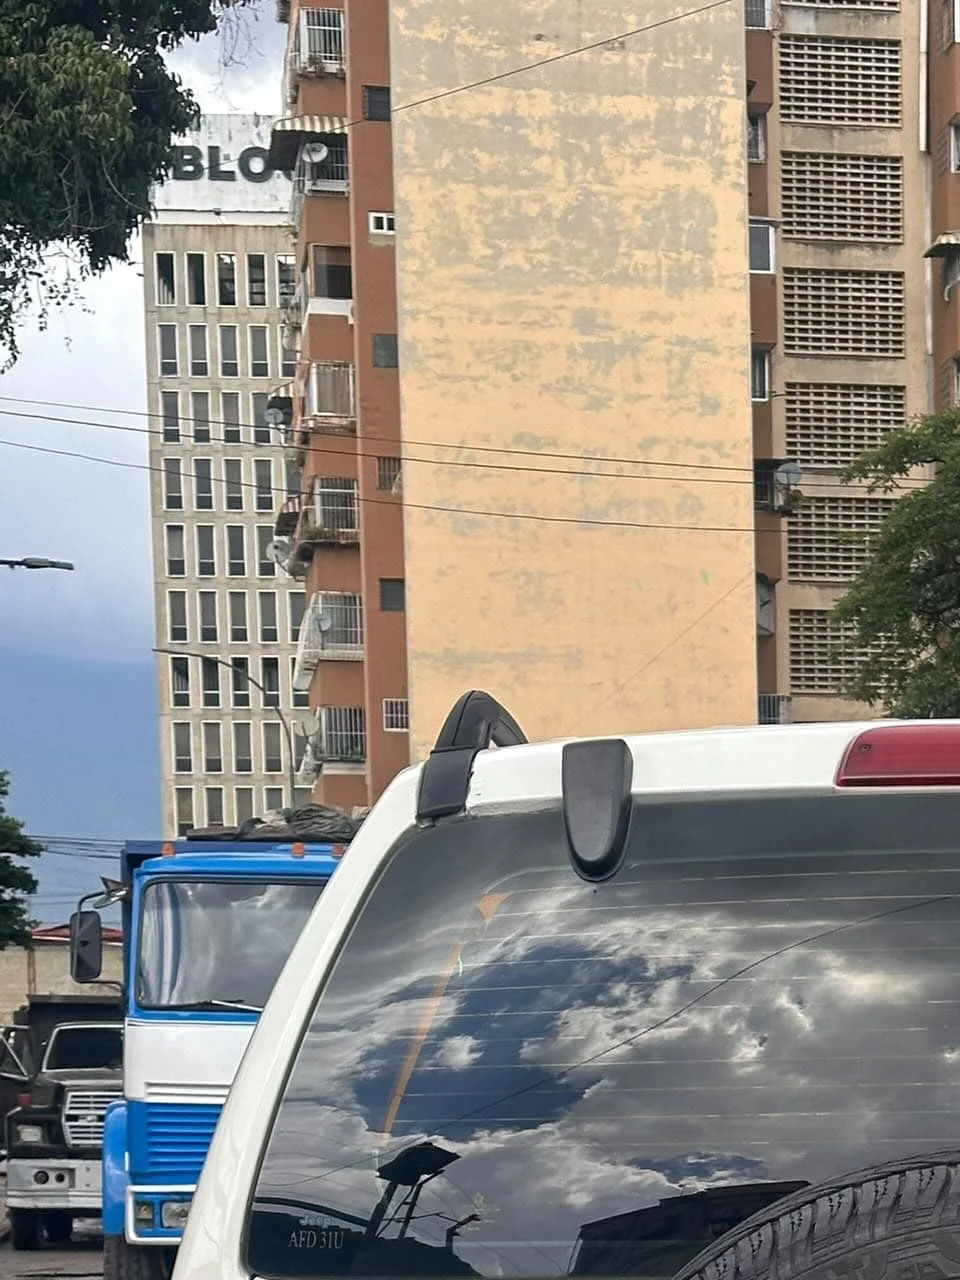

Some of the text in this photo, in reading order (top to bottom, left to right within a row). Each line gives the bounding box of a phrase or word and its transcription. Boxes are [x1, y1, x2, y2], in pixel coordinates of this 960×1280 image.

[170, 145, 293, 184] BLO
[287, 1231, 345, 1249] AFD 31U
